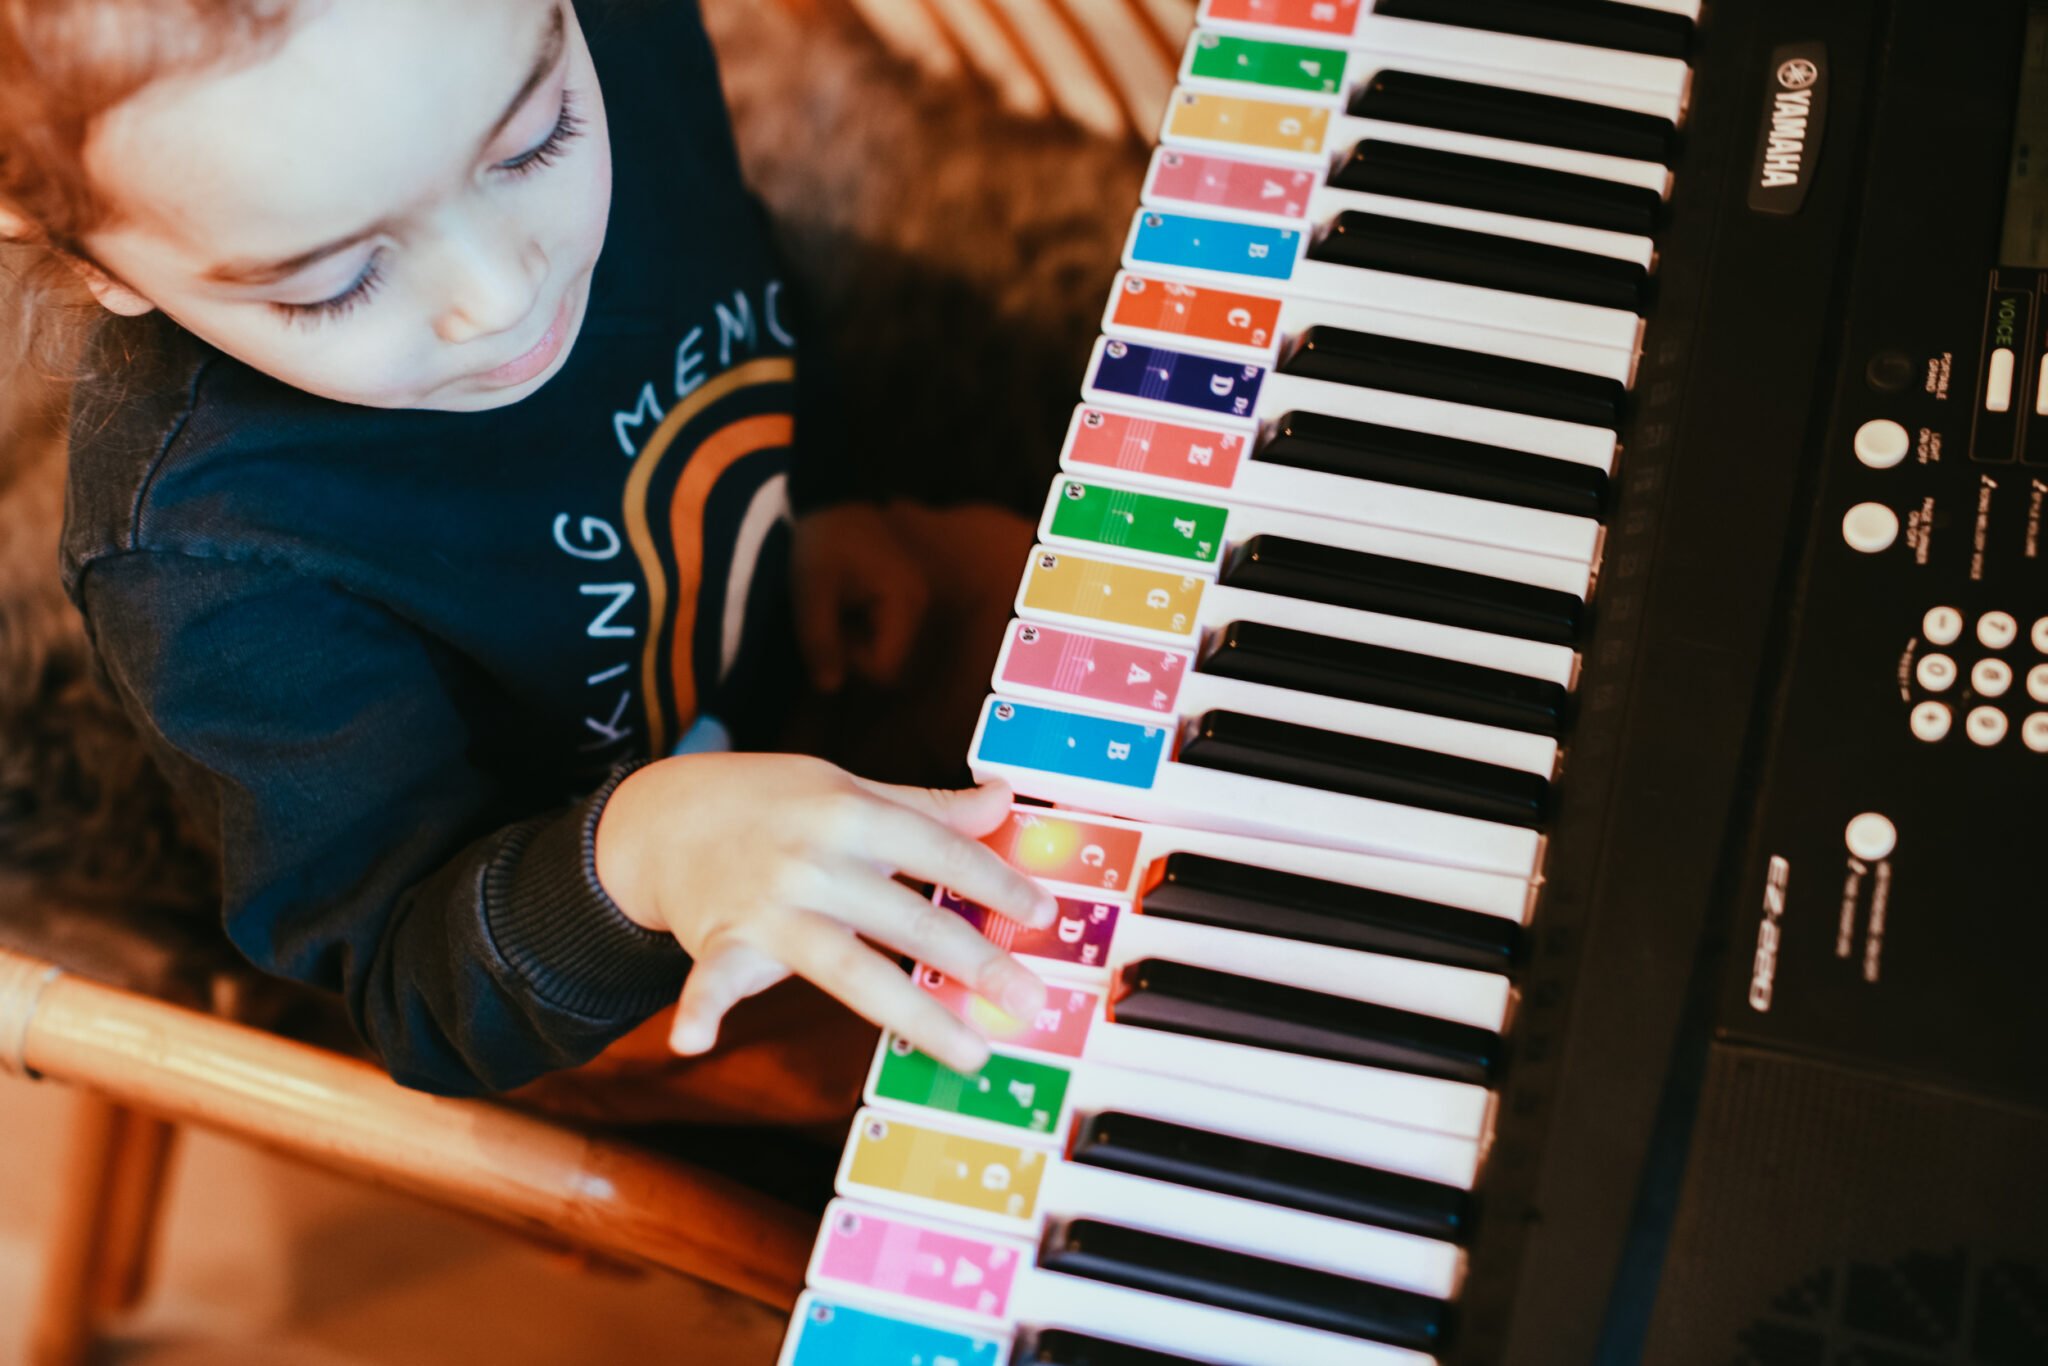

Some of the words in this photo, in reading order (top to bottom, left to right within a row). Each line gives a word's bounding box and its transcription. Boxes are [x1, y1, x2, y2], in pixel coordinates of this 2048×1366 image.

[1279, 118, 1301, 135] G
[1761, 89, 1812, 187] YAMAHA
[1261, 179, 1285, 199] A
[1249, 243, 1269, 258] B
[1227, 308, 1251, 328] C
[1996, 298, 2016, 346] VOICE
[1210, 373, 1235, 396] D
[1926, 358, 1939, 393] GRAND
[1936, 352, 1952, 400] PORTABLE
[1187, 444, 1213, 466] E
[1931, 432, 1941, 461] LIGHT
[1173, 516, 1197, 538] F
[1146, 588, 1171, 609] G
[1126, 661, 1152, 686] A
[1107, 740, 1131, 761] B
[1080, 844, 1105, 867] C
[1058, 916, 1086, 943] D
[1750, 855, 1790, 1012] EZ-220
[1034, 1009, 1062, 1033] E
[1008, 1079, 1036, 1108] F
[981, 1163, 1011, 1190] G
[952, 1256, 984, 1288] A
